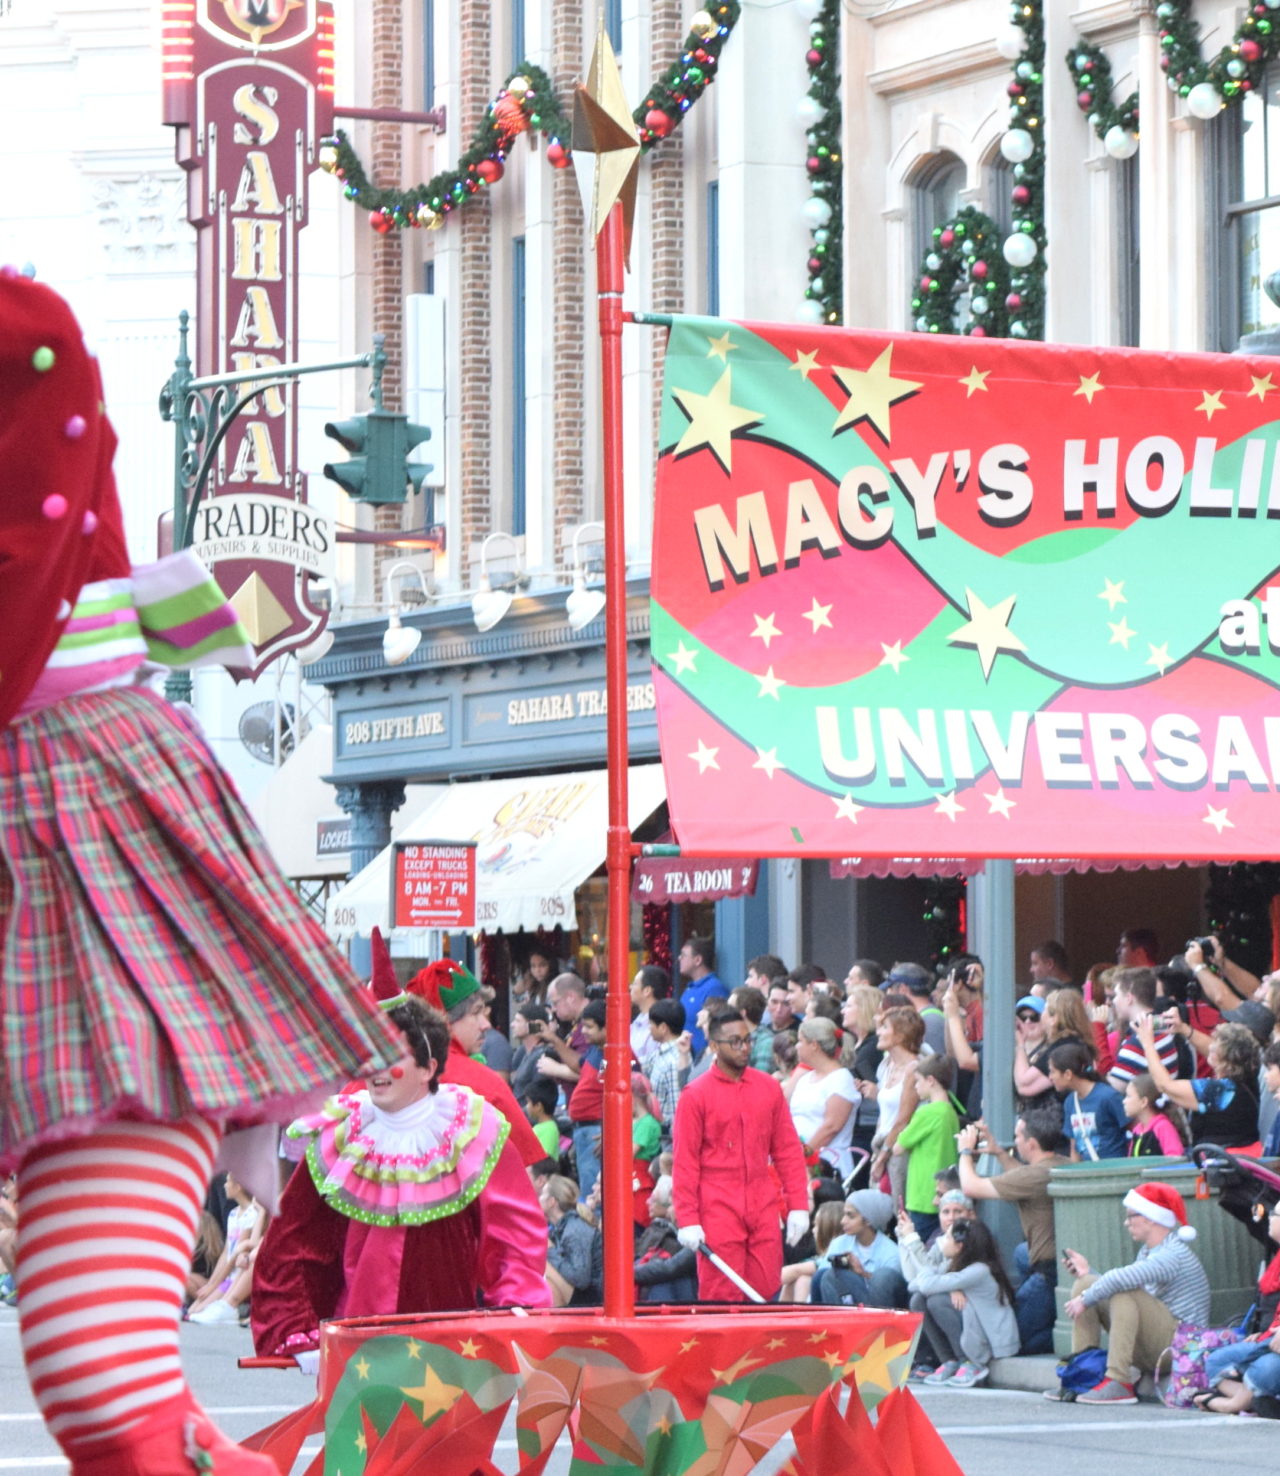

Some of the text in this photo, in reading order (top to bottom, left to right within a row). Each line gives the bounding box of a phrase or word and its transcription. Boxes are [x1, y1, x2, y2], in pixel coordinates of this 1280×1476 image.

[230, 82, 286, 485] SAHARA
[198, 502, 328, 553] RADERS
[694, 443, 1033, 592] MACY'S
[252, 542, 261, 554] &
[268, 541, 319, 567] SUPPLIES
[508, 693, 575, 725] SAHARA
[577, 683, 656, 717] TRAERS
[346, 719, 370, 745] 208
[372, 715, 414, 742] FIFTH
[404, 846, 467, 859] NO STANDING
[404, 860, 467, 870] EXCEPT TRUCKS
[405, 881, 412, 895] 8
[452, 882, 467, 895] PM
[665, 872, 691, 893] TEA
[693, 868, 732, 892] ROOM
[334, 906, 356, 926] 208
